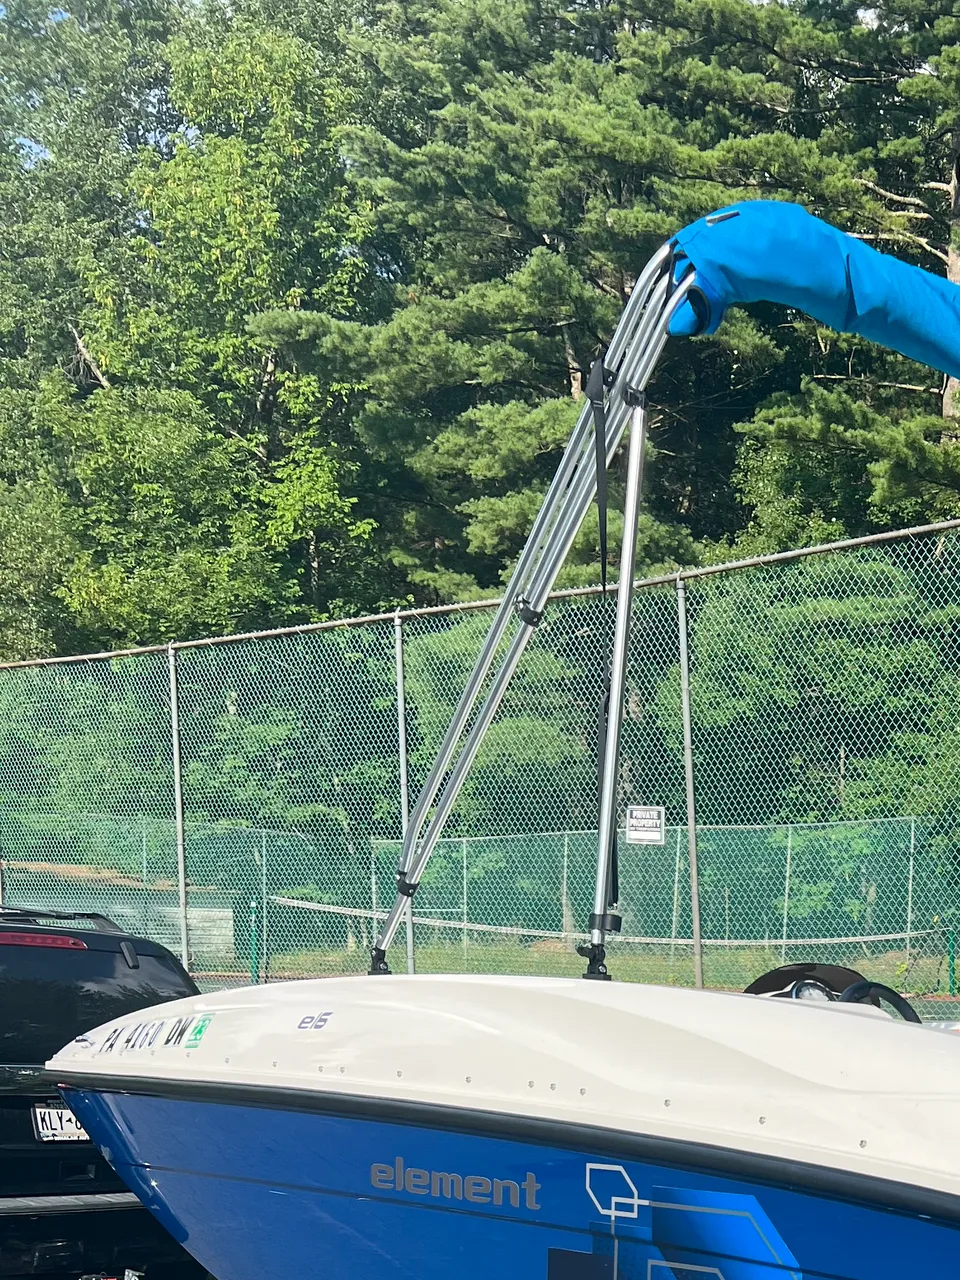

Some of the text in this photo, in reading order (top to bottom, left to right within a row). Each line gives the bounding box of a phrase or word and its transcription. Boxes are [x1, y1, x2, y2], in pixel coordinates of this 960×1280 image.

[99, 1027, 125, 1053] PA
[124, 1022, 166, 1050] 4160
[163, 1017, 195, 1045] DW
[370, 1156, 542, 1210] element
